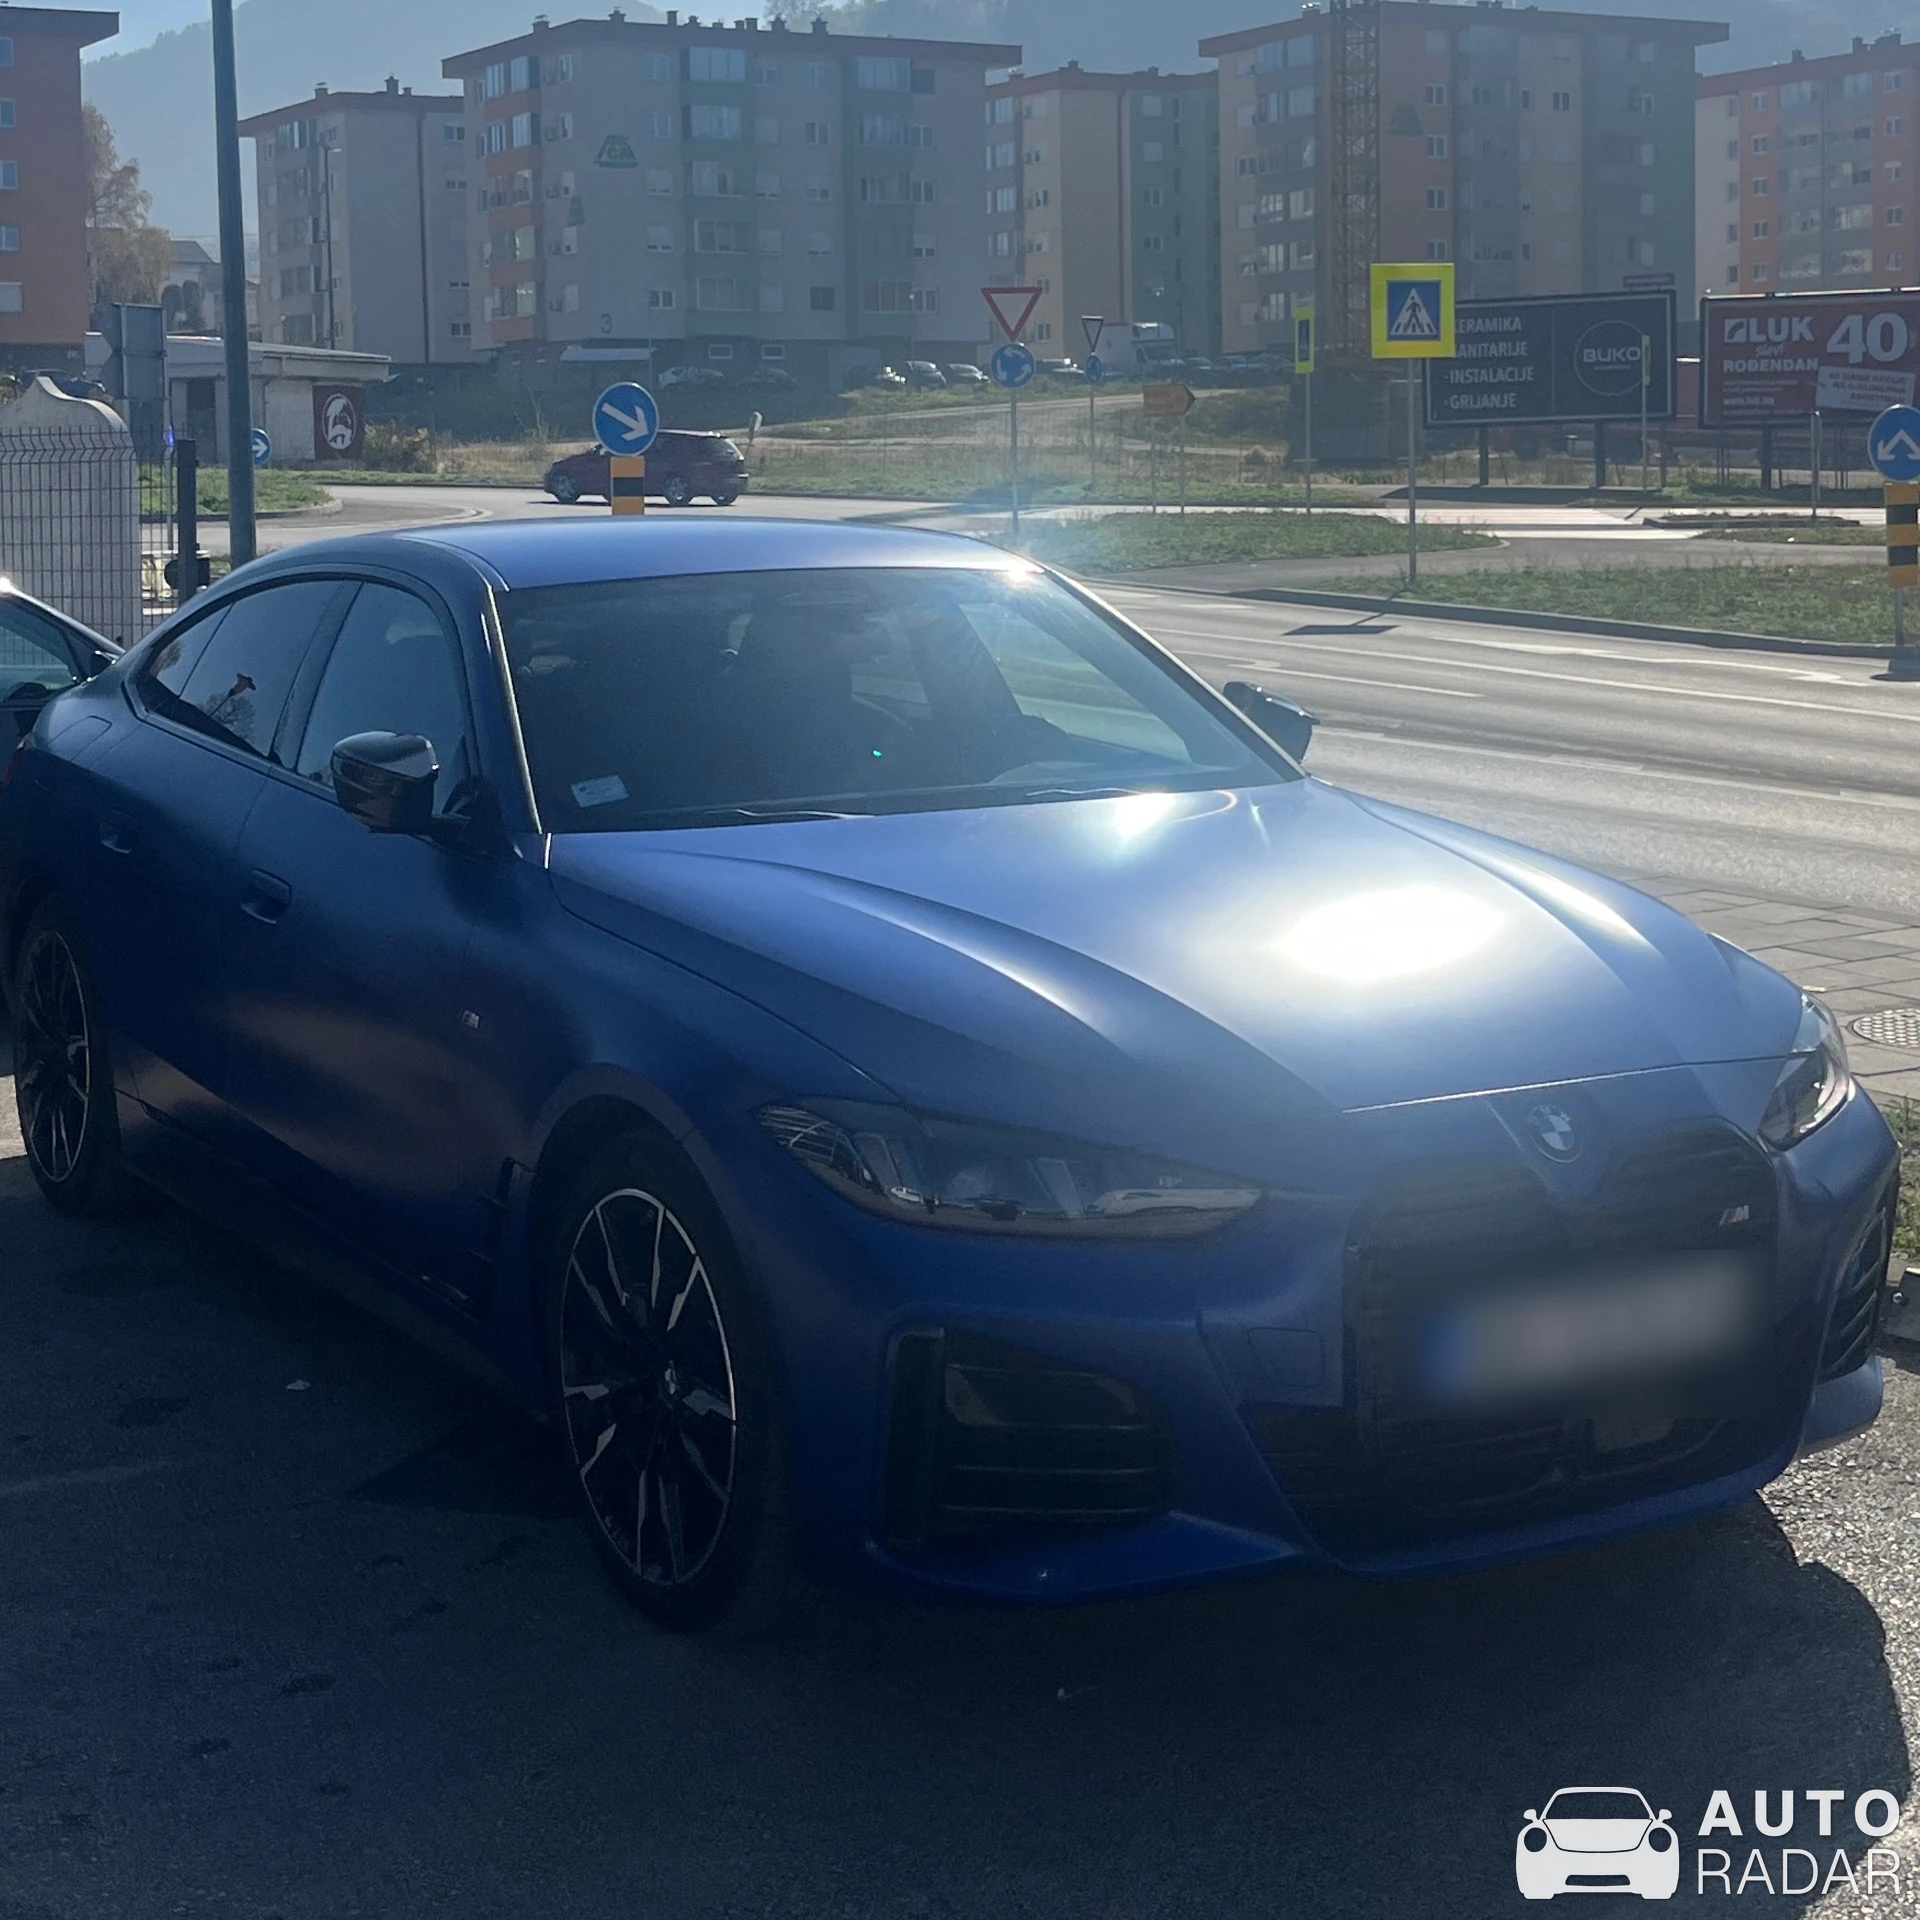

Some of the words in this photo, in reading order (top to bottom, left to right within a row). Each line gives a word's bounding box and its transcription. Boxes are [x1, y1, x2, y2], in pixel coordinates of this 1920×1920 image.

[1455, 316, 1522, 334] ERAMIKA
[1748, 316, 1815, 342] LUK
[1827, 312, 1908, 364] 40
[1455, 341, 1528, 359] ANITARIJE
[1582, 346, 1641, 363] BUKO
